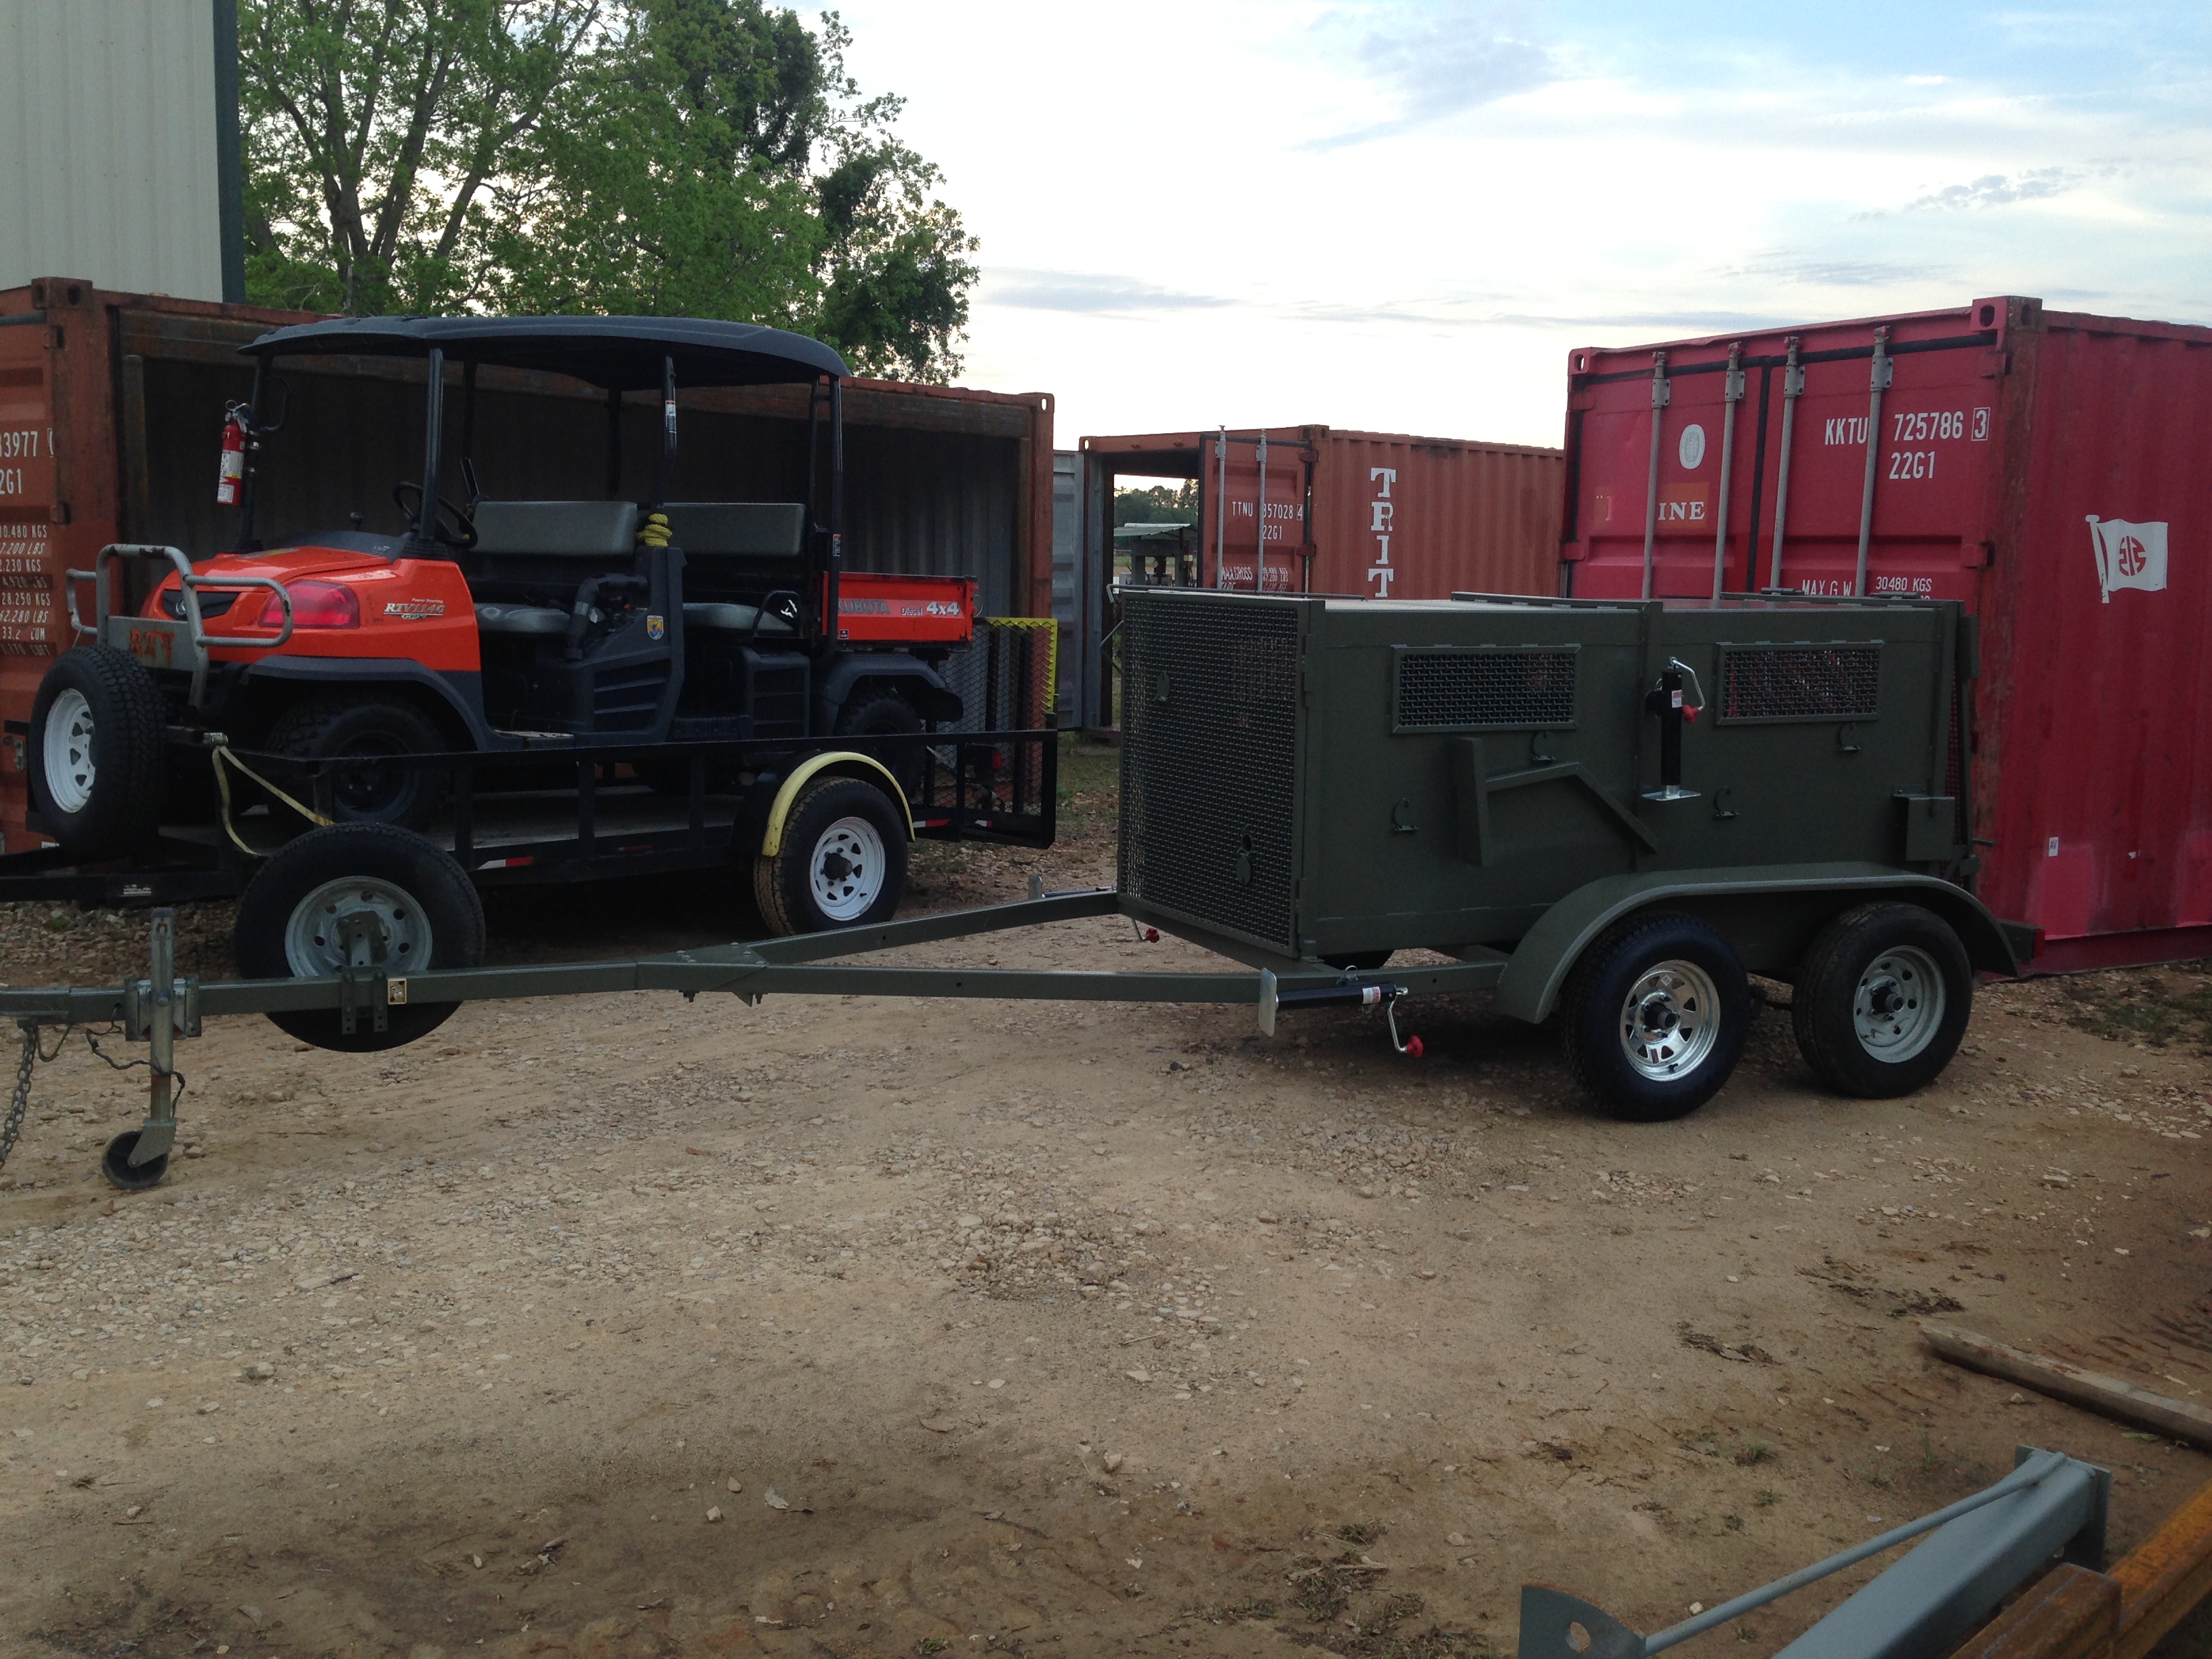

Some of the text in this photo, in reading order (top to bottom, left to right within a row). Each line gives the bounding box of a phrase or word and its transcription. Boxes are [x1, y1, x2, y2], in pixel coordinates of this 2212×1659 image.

[1825, 409, 1987, 445] KKTU 725786 3
[0, 430, 39, 457] 3977
[1889, 451, 1936, 480] 22G1
[1232, 501, 1253, 517] TTNU
[32, 525, 47, 538] KGS
[1368, 468, 1396, 598] TRIT
[27, 543, 45, 554] LBS
[26, 559, 41, 573] KGS
[1803, 579, 1826, 595] MAX
[35, 593, 51, 607] KGS
[384, 603, 446, 613] RTV1140
[902, 608, 923, 616] Diesel
[926, 602, 959, 615] 4x4
